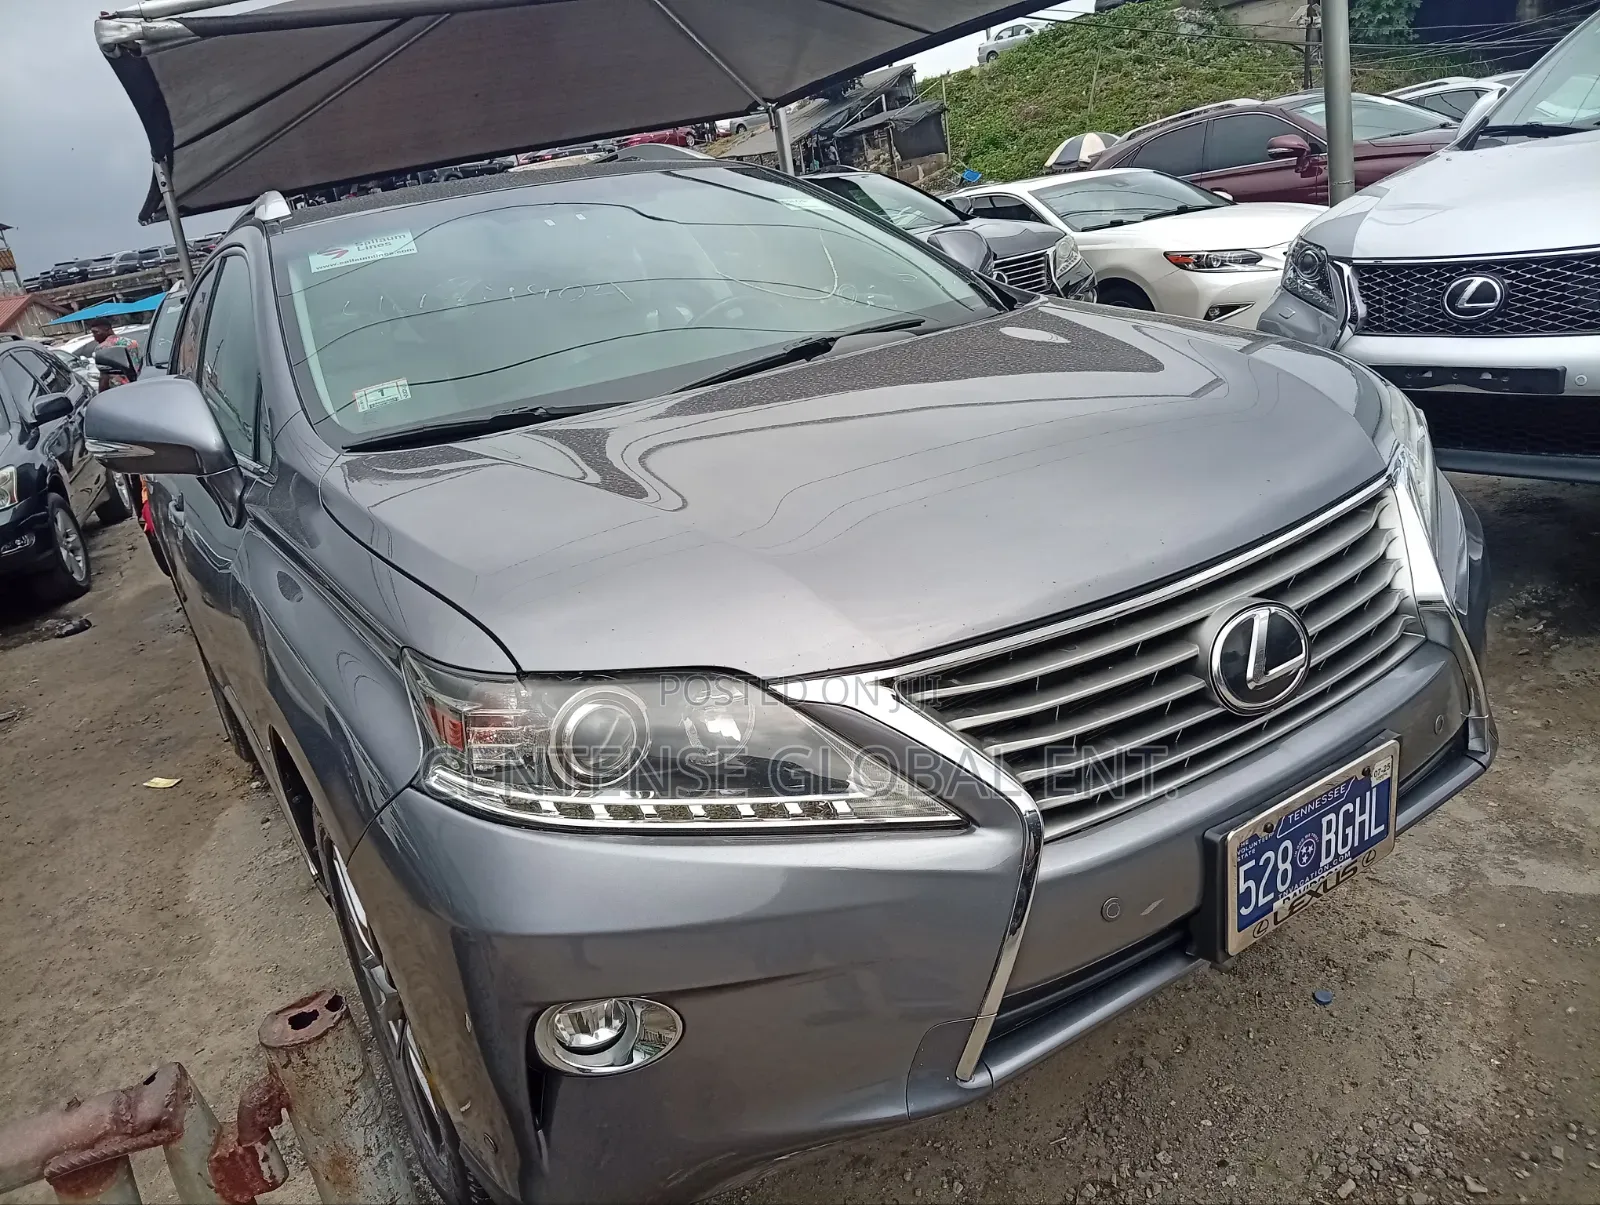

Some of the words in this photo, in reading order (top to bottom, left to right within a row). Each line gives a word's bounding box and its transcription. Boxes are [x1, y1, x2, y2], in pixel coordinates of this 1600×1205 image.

[357, 241, 392, 252] Lines
[1288, 783, 1347, 824] TENNESSEE
[1239, 839, 1293, 916] 528
[1320, 786, 1386, 868] BGHL
[1273, 859, 1358, 926] LEXUS
